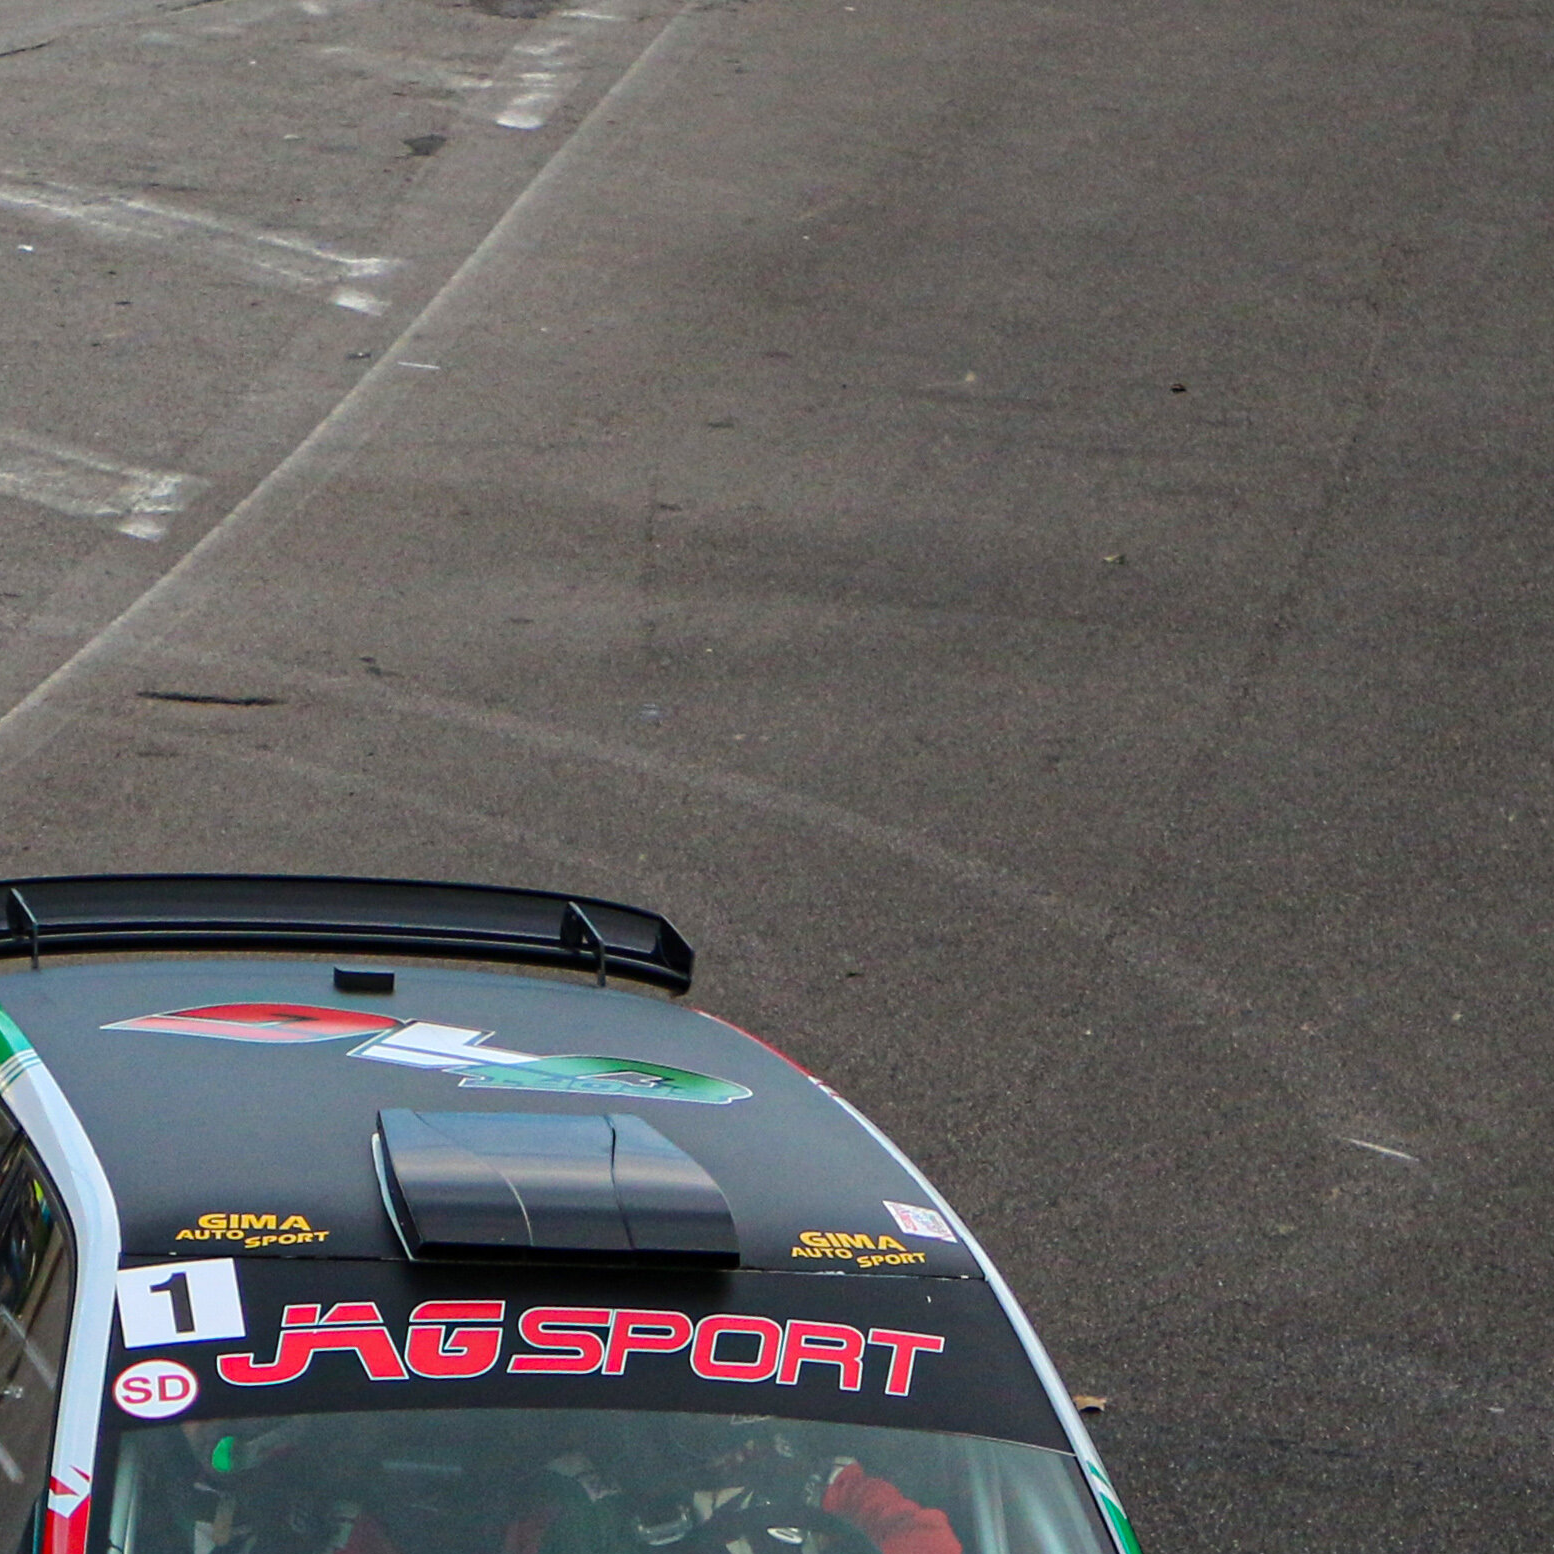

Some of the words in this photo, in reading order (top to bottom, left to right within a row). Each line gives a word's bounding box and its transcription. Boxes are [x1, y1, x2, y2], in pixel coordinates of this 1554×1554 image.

[198, 1213, 311, 1231] GIMA
[175, 1229, 244, 1240] AUTO
[244, 1231, 330, 1249] SPORT
[799, 1231, 907, 1251] GIMA
[791, 1247, 853, 1259] AUTO
[856, 1252, 925, 1268] SPORT
[149, 1271, 196, 1334] 1
[122, 1374, 190, 1404] SD
